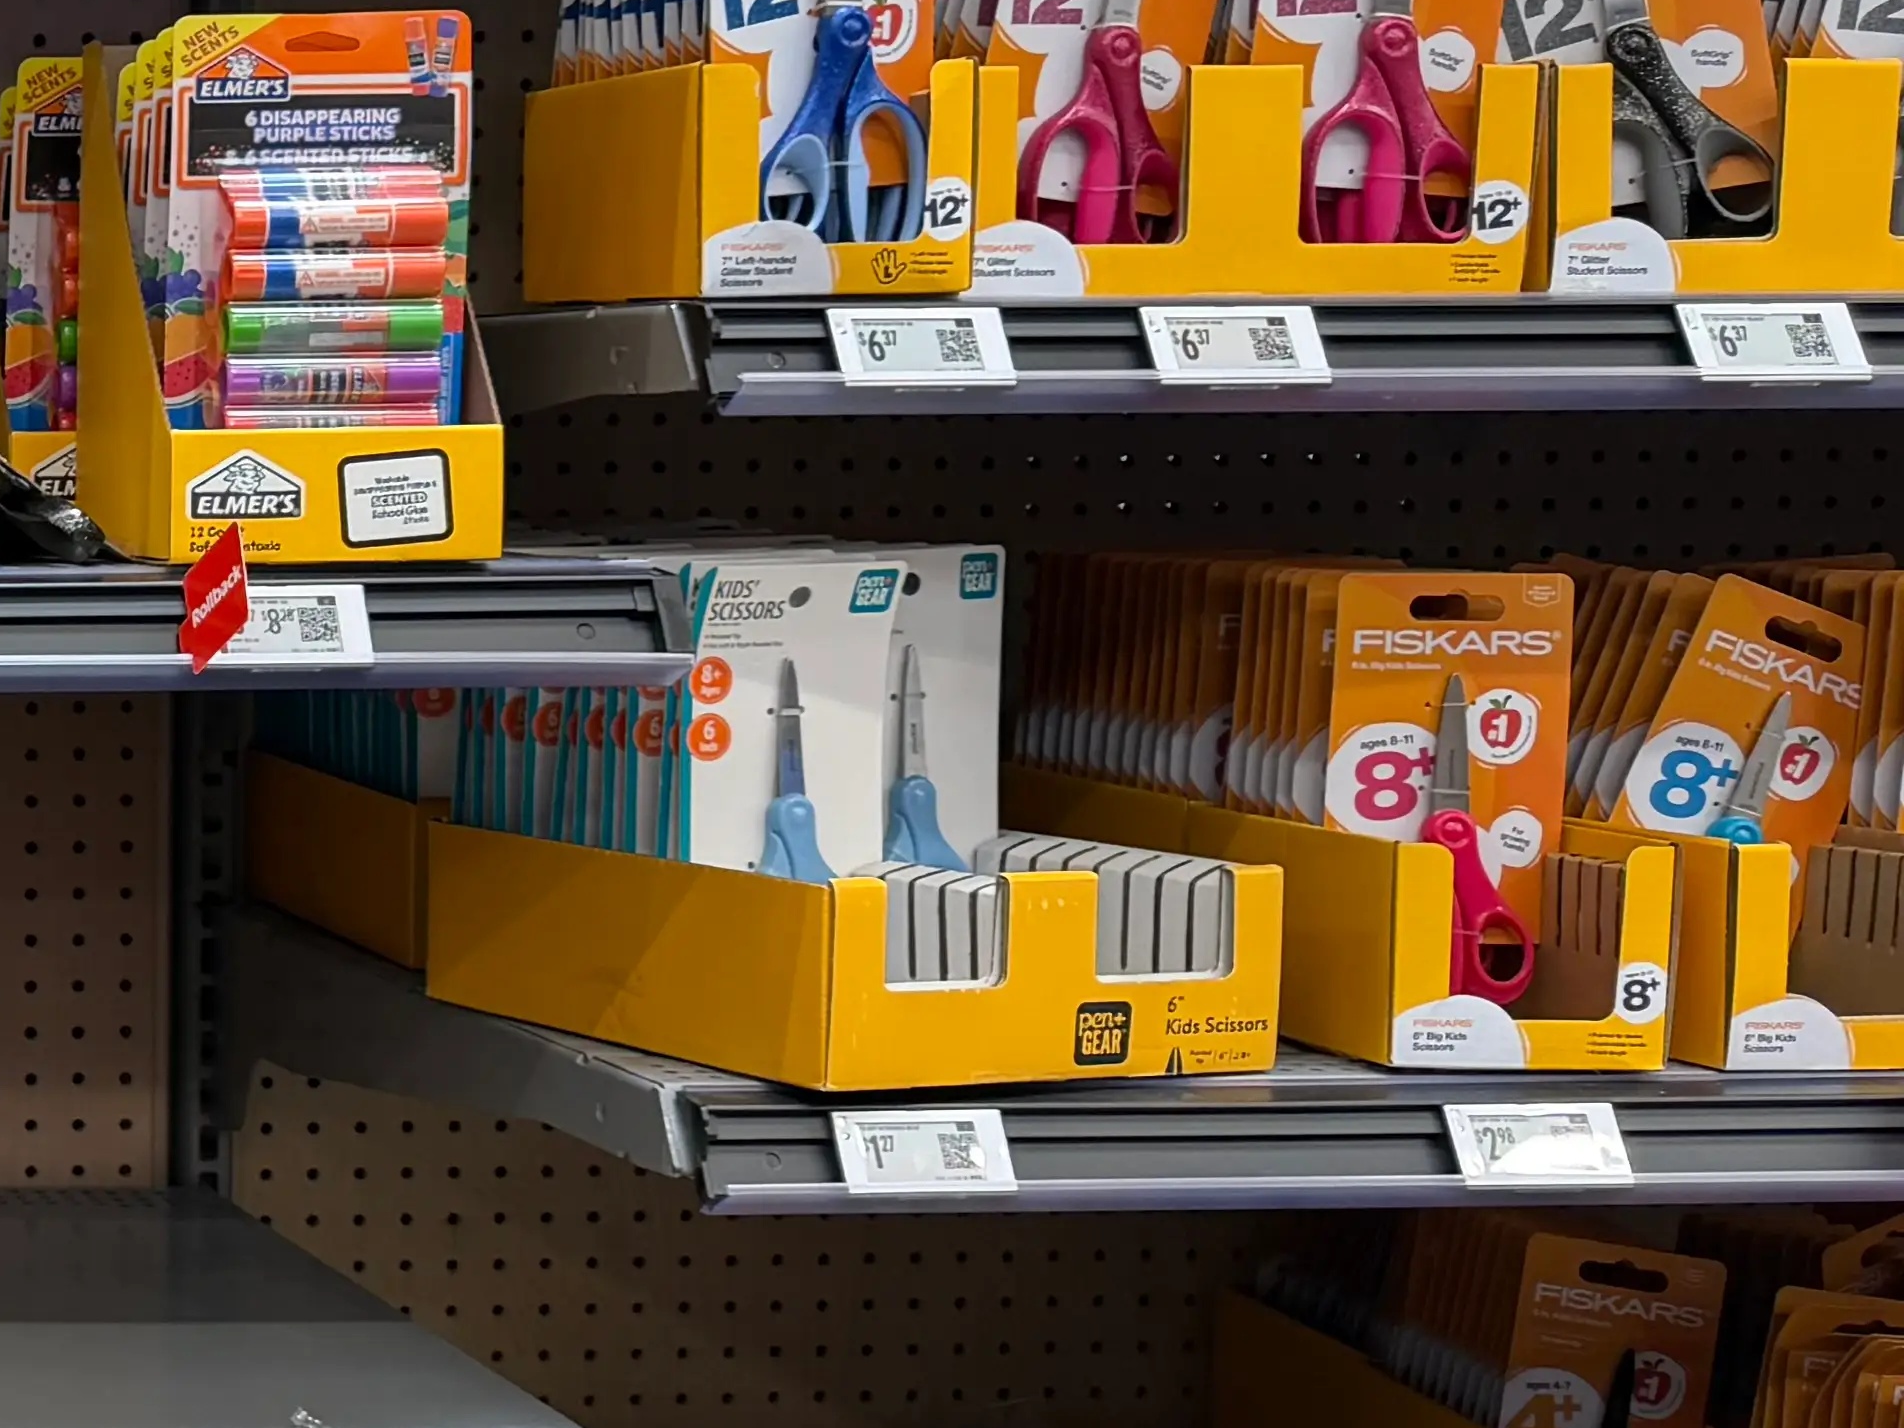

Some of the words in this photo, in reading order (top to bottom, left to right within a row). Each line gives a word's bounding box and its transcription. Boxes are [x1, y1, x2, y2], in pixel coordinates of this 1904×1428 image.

[180, 26, 240, 68] SCENTS
[183, 22, 219, 51] NEW
[200, 79, 285, 97] ELMER'S
[197, 495, 295, 516] ELMER'S
[191, 566, 244, 631] Rollback
[1353, 629, 1553, 655] FISKARS
[1705, 627, 1862, 710] FISKARS
[702, 719, 717, 739] 6
[1167, 996, 1185, 1014] 6"
[1166, 1016, 1201, 1037] Kids
[1205, 1014, 1268, 1035] Scissors
[1082, 1029, 1122, 1055] GEAR
[1534, 1281, 1705, 1329] FISKARS
